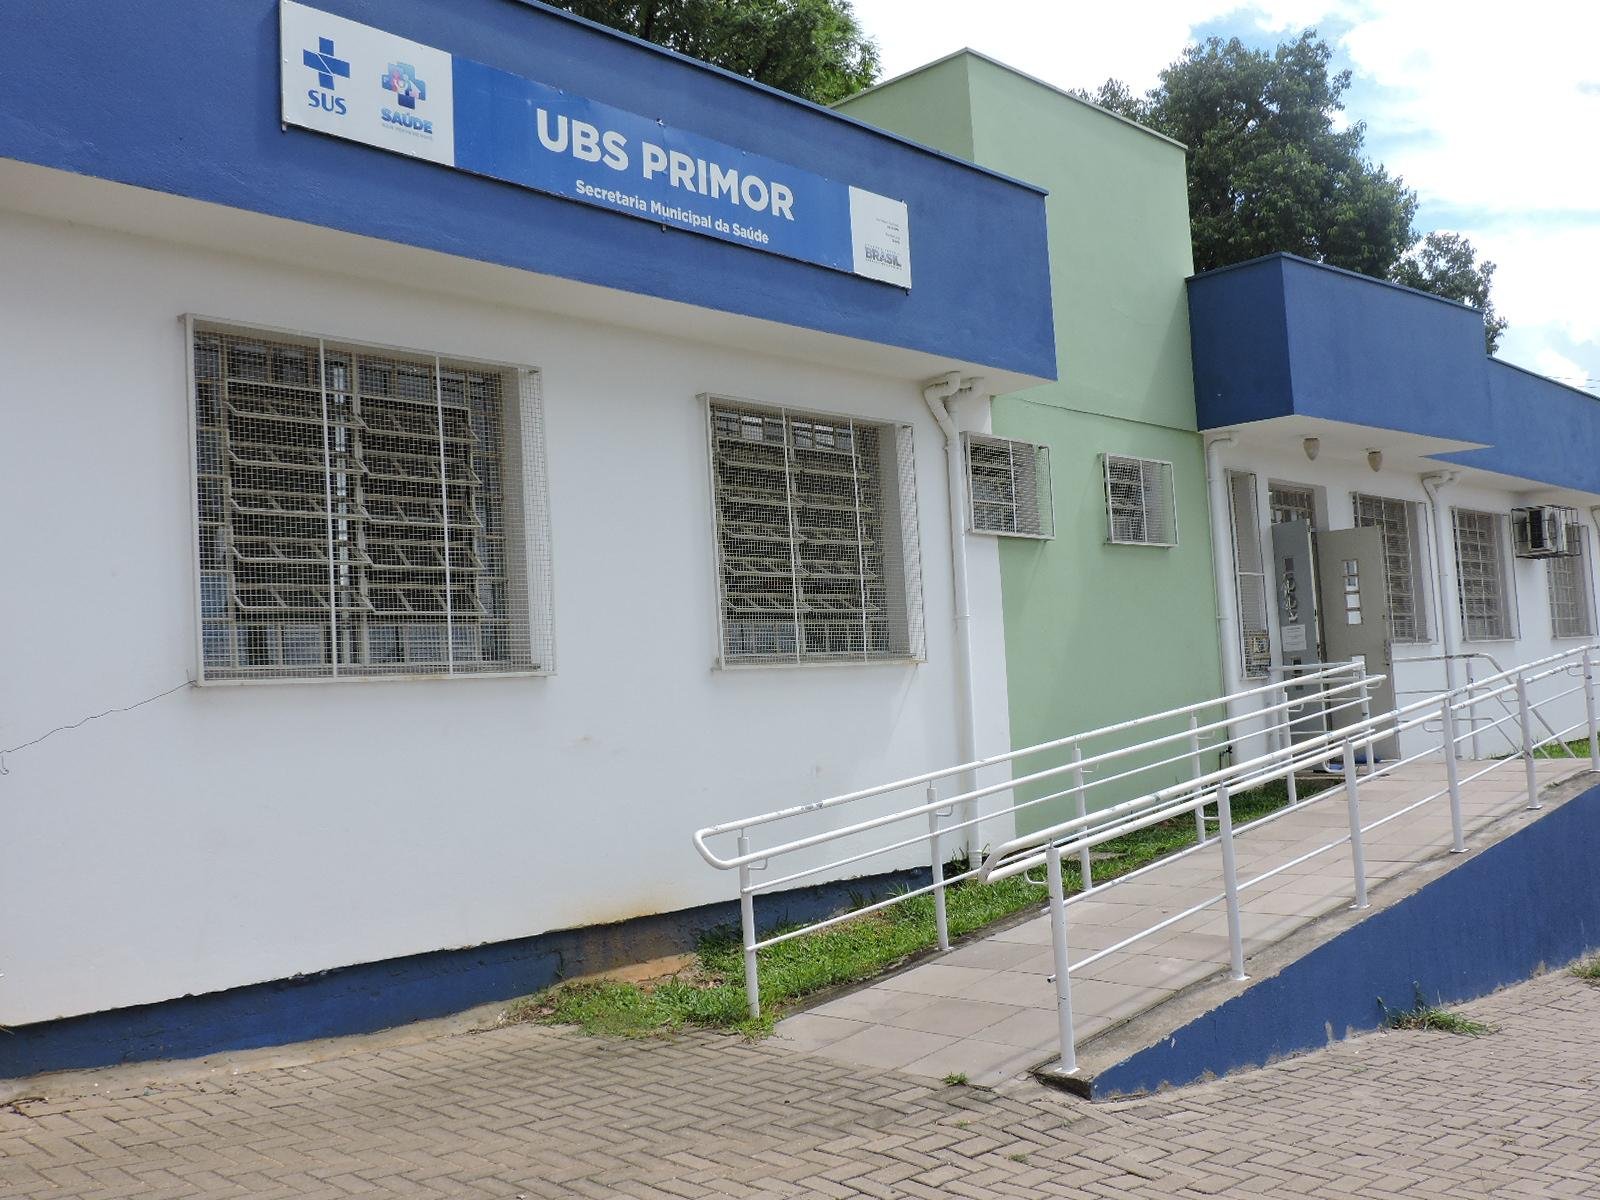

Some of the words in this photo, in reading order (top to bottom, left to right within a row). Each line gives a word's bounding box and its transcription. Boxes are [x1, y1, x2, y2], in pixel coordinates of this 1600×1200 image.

[308, 90, 347, 115] SUS
[381, 108, 433, 134] SAÚDE
[537, 108, 628, 171] UBS
[642, 141, 794, 221] PRIMOR
[576, 180, 647, 212] Secretaria
[650, 200, 712, 229] Municipal
[715, 218, 730, 233] da
[733, 223, 769, 244] Saúde
[865, 246, 902, 268] BRASIL
